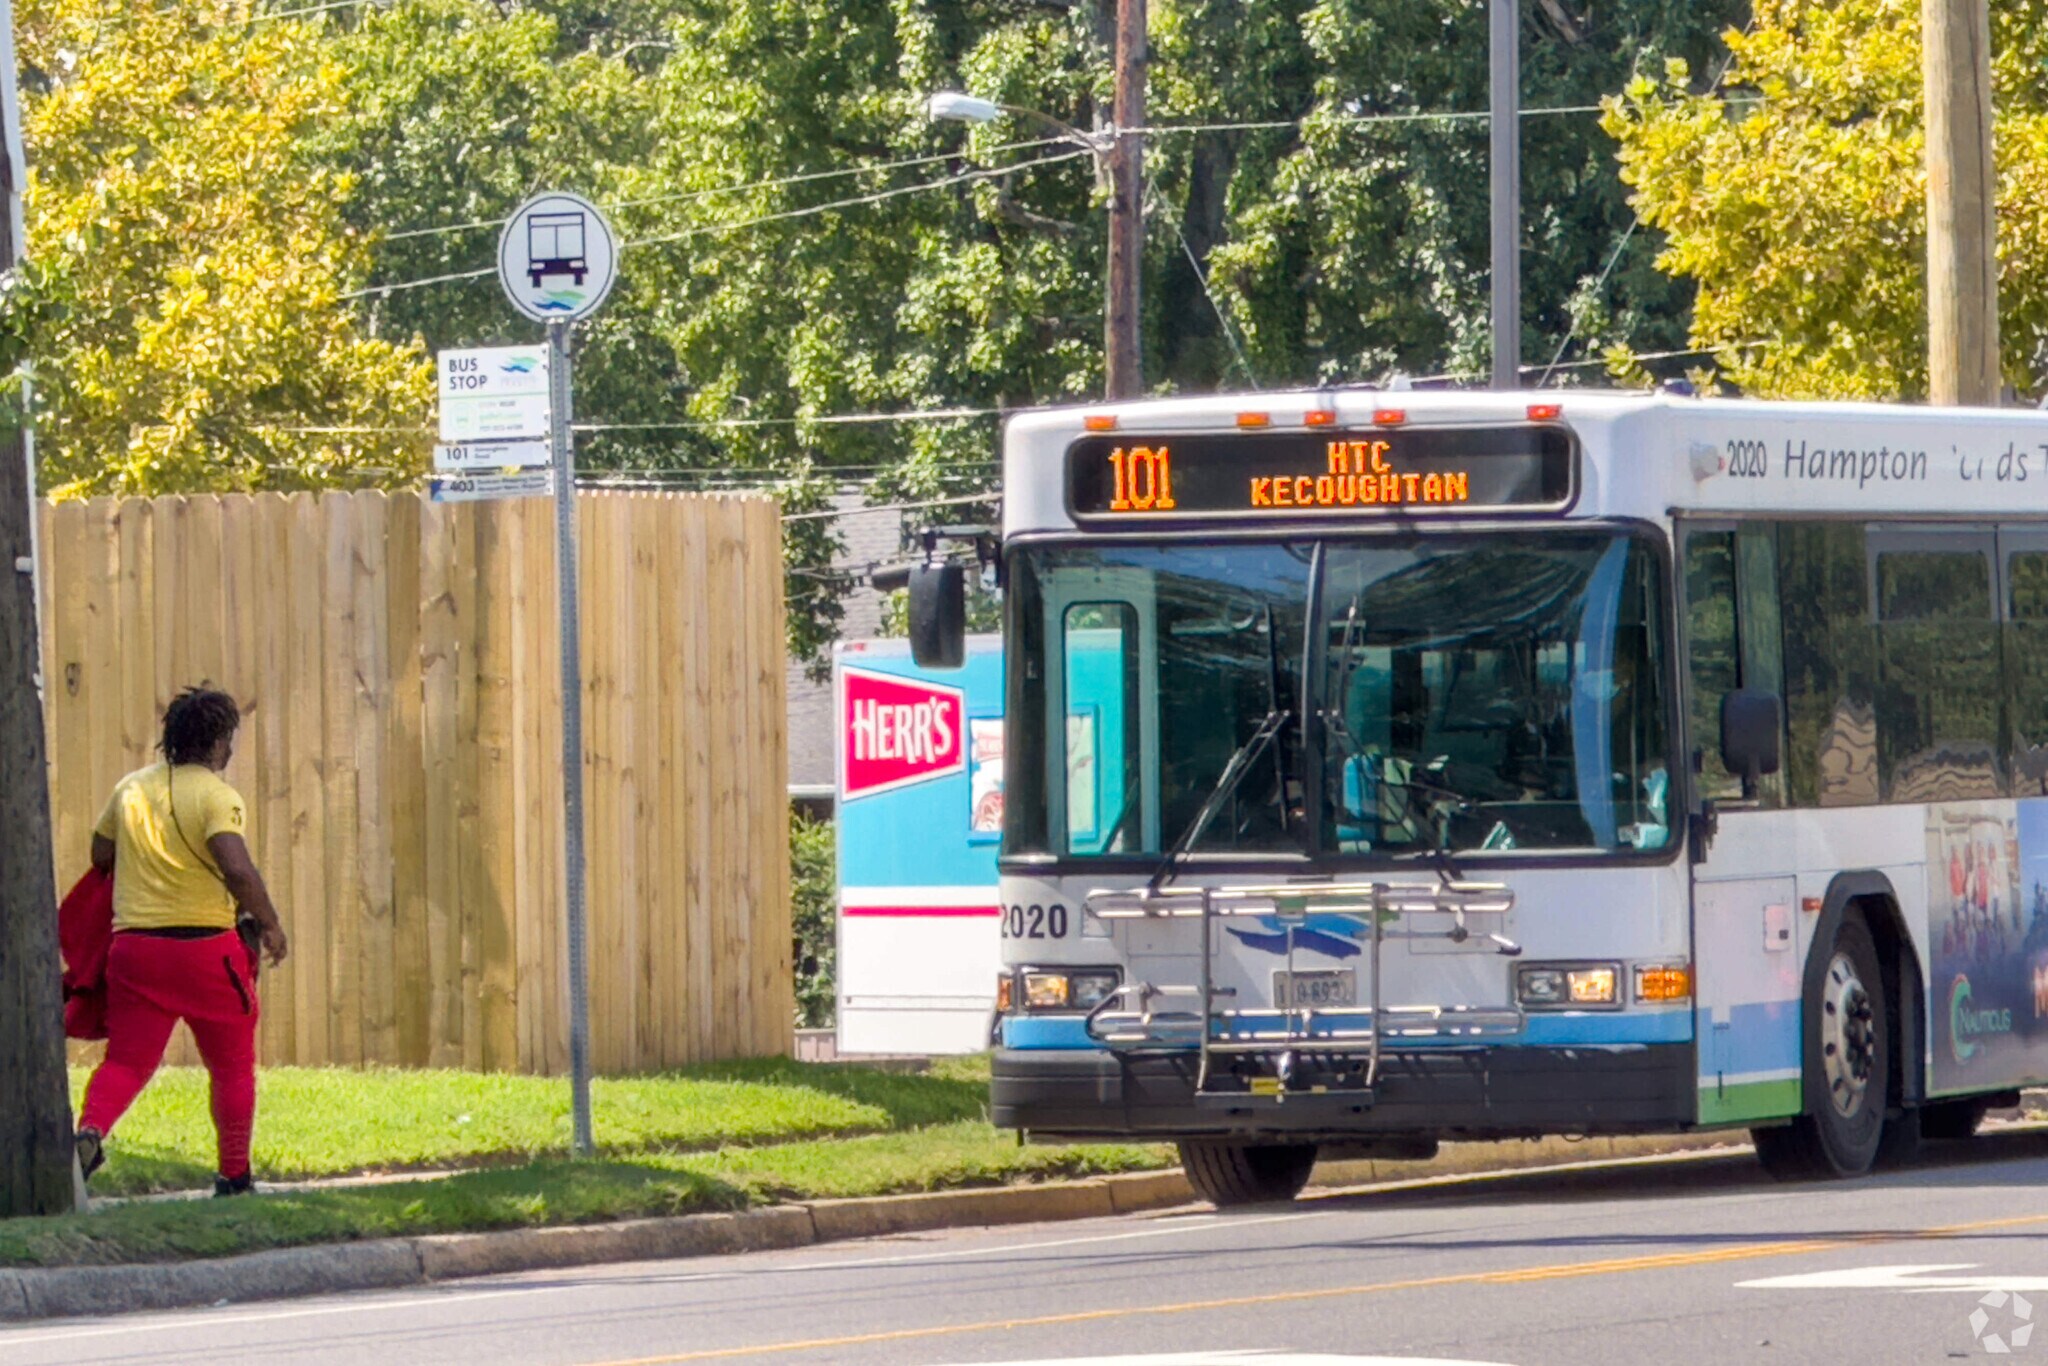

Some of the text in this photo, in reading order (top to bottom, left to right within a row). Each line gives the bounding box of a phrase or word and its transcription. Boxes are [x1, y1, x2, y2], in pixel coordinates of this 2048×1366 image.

[449, 358, 478, 373] BUS
[449, 375, 488, 390] STOP
[446, 447, 468, 460] 101
[1327, 440, 1391, 474] HTC
[1727, 440, 1767, 477] 2020
[1784, 439, 1927, 489] Hampton
[1108, 445, 1175, 510] 101
[1250, 472, 1468, 507] KECOUGHTAN
[852, 696, 953, 764] HERR'S
[1001, 903, 1068, 939] 2020
